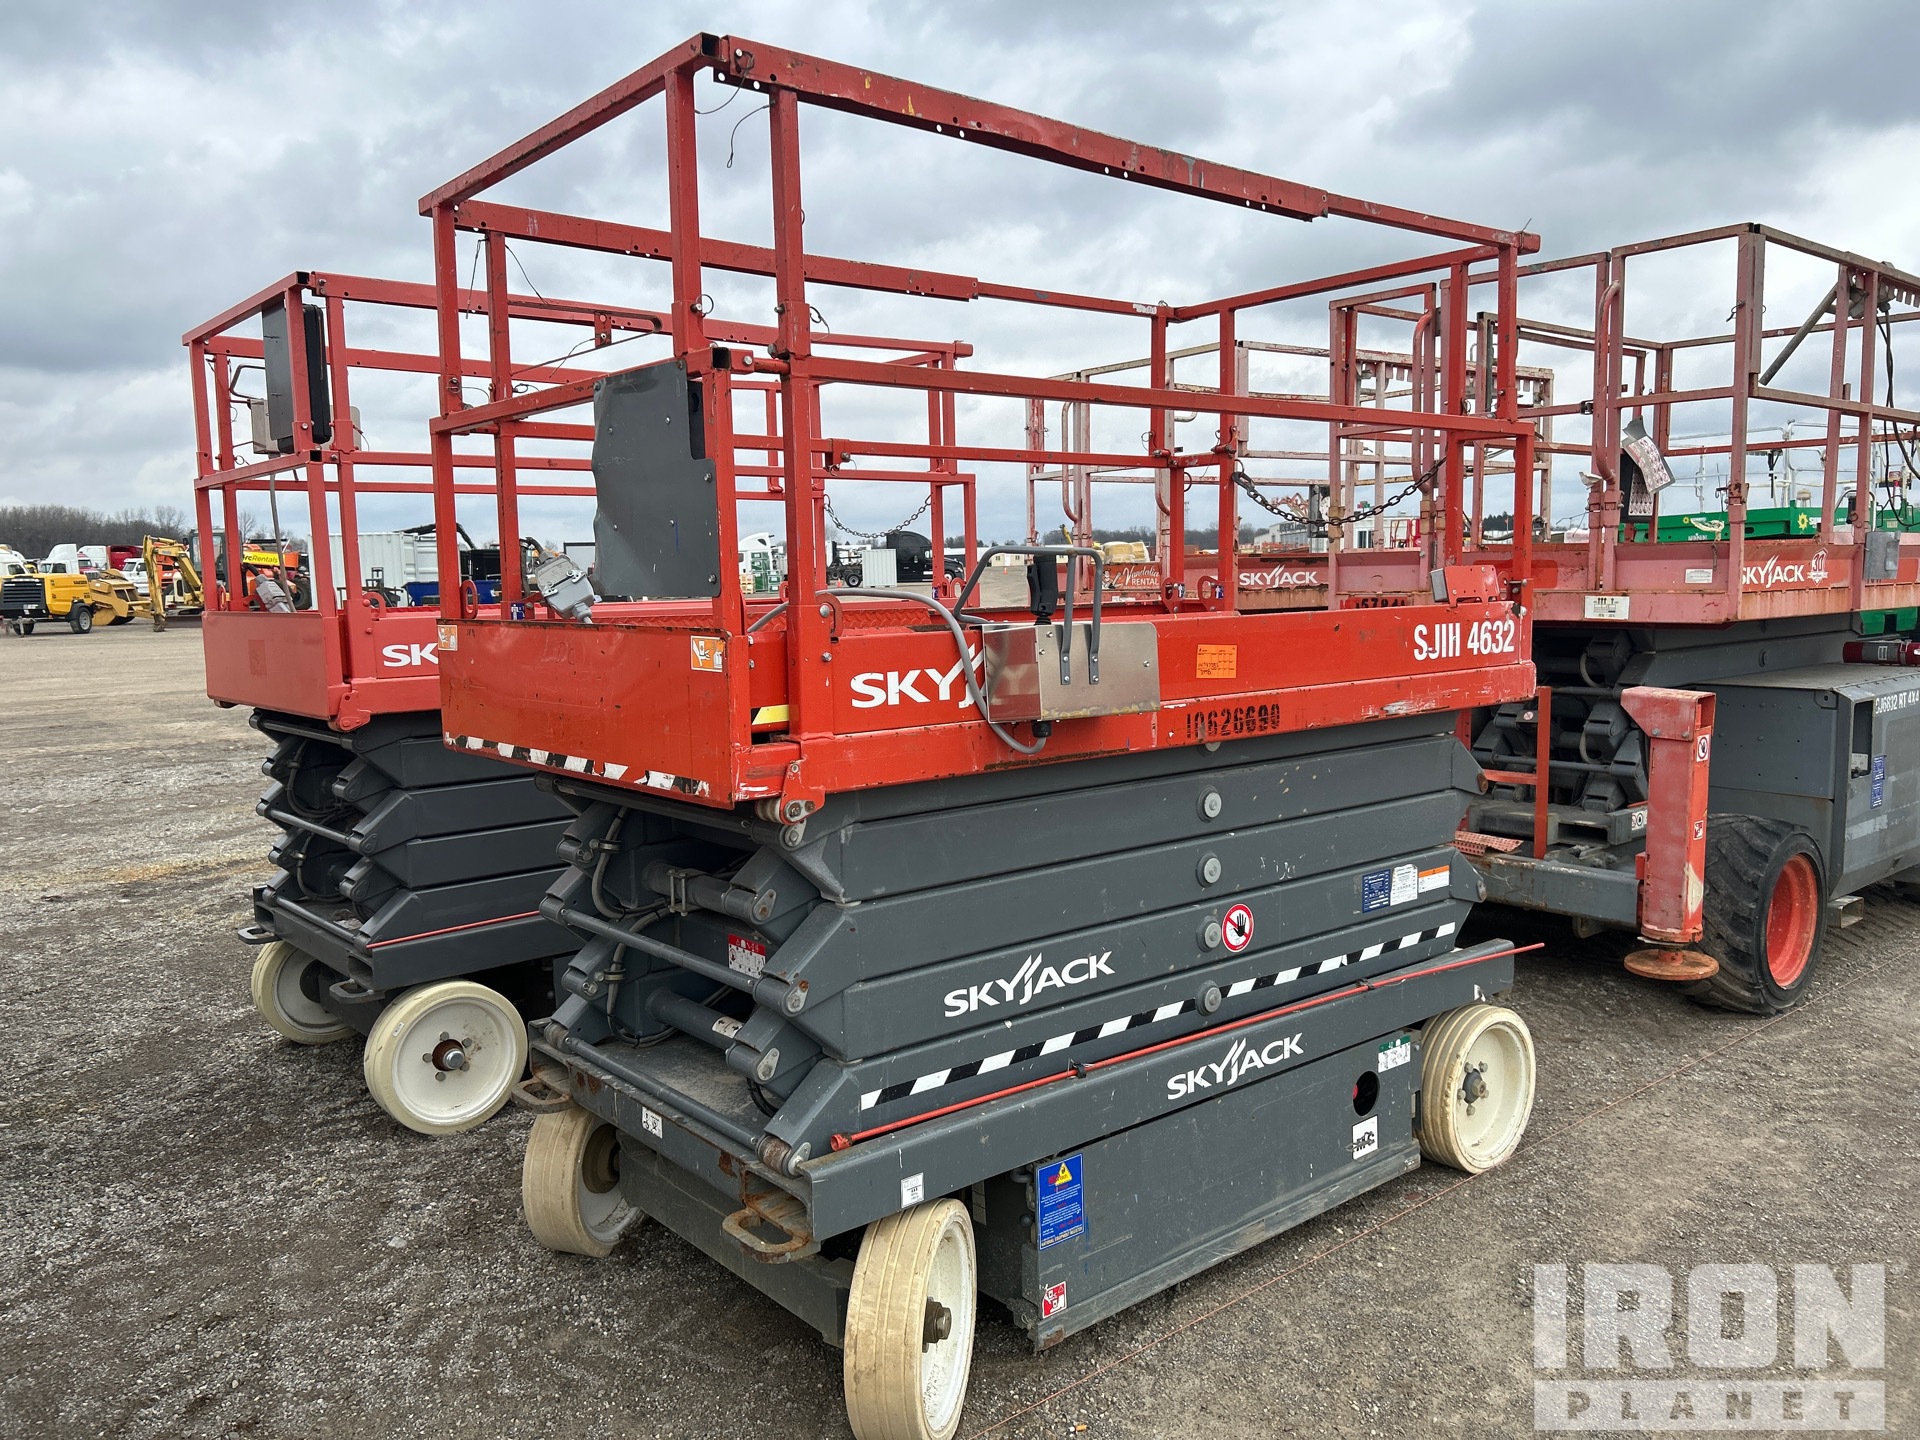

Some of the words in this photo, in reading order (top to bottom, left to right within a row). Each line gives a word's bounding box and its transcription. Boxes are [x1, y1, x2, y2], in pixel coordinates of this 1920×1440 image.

[1131, 578, 1159, 586] RENTAL
[1239, 564, 1318, 588] SKYJACK
[1467, 619, 1515, 655] 4632
[943, 950, 1115, 1018] SKYJACK
[1167, 1032, 1304, 1100] SKYJACK
